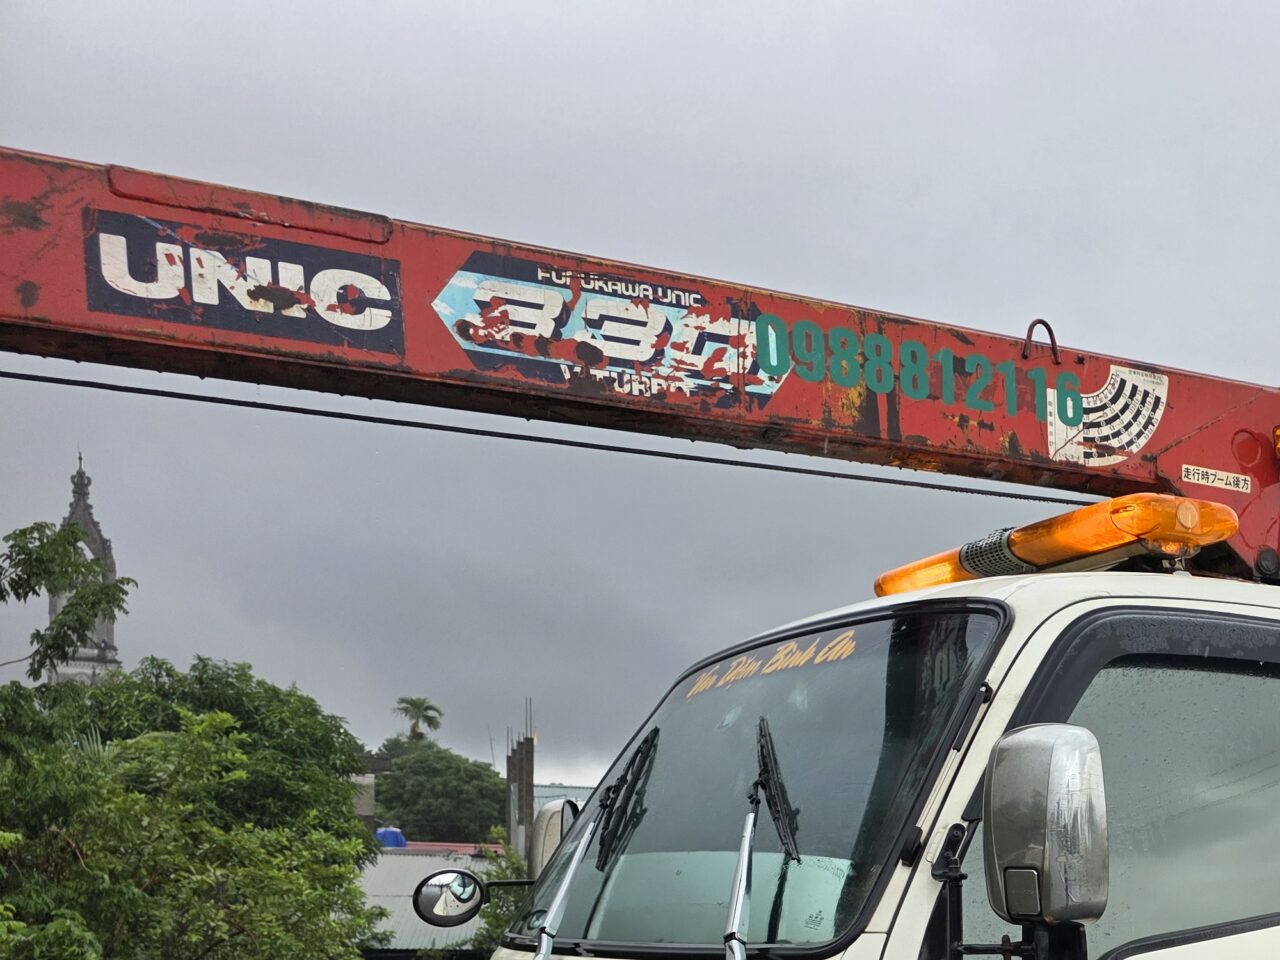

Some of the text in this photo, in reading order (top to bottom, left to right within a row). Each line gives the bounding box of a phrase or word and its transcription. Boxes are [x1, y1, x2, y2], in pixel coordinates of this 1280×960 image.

[99, 232, 392, 330] UNIC
[658, 288, 702, 308] UNIC
[755, 312, 1084, 427] 0988812116
[1183, 466, 1249, 491] 走行時ブーム後方
